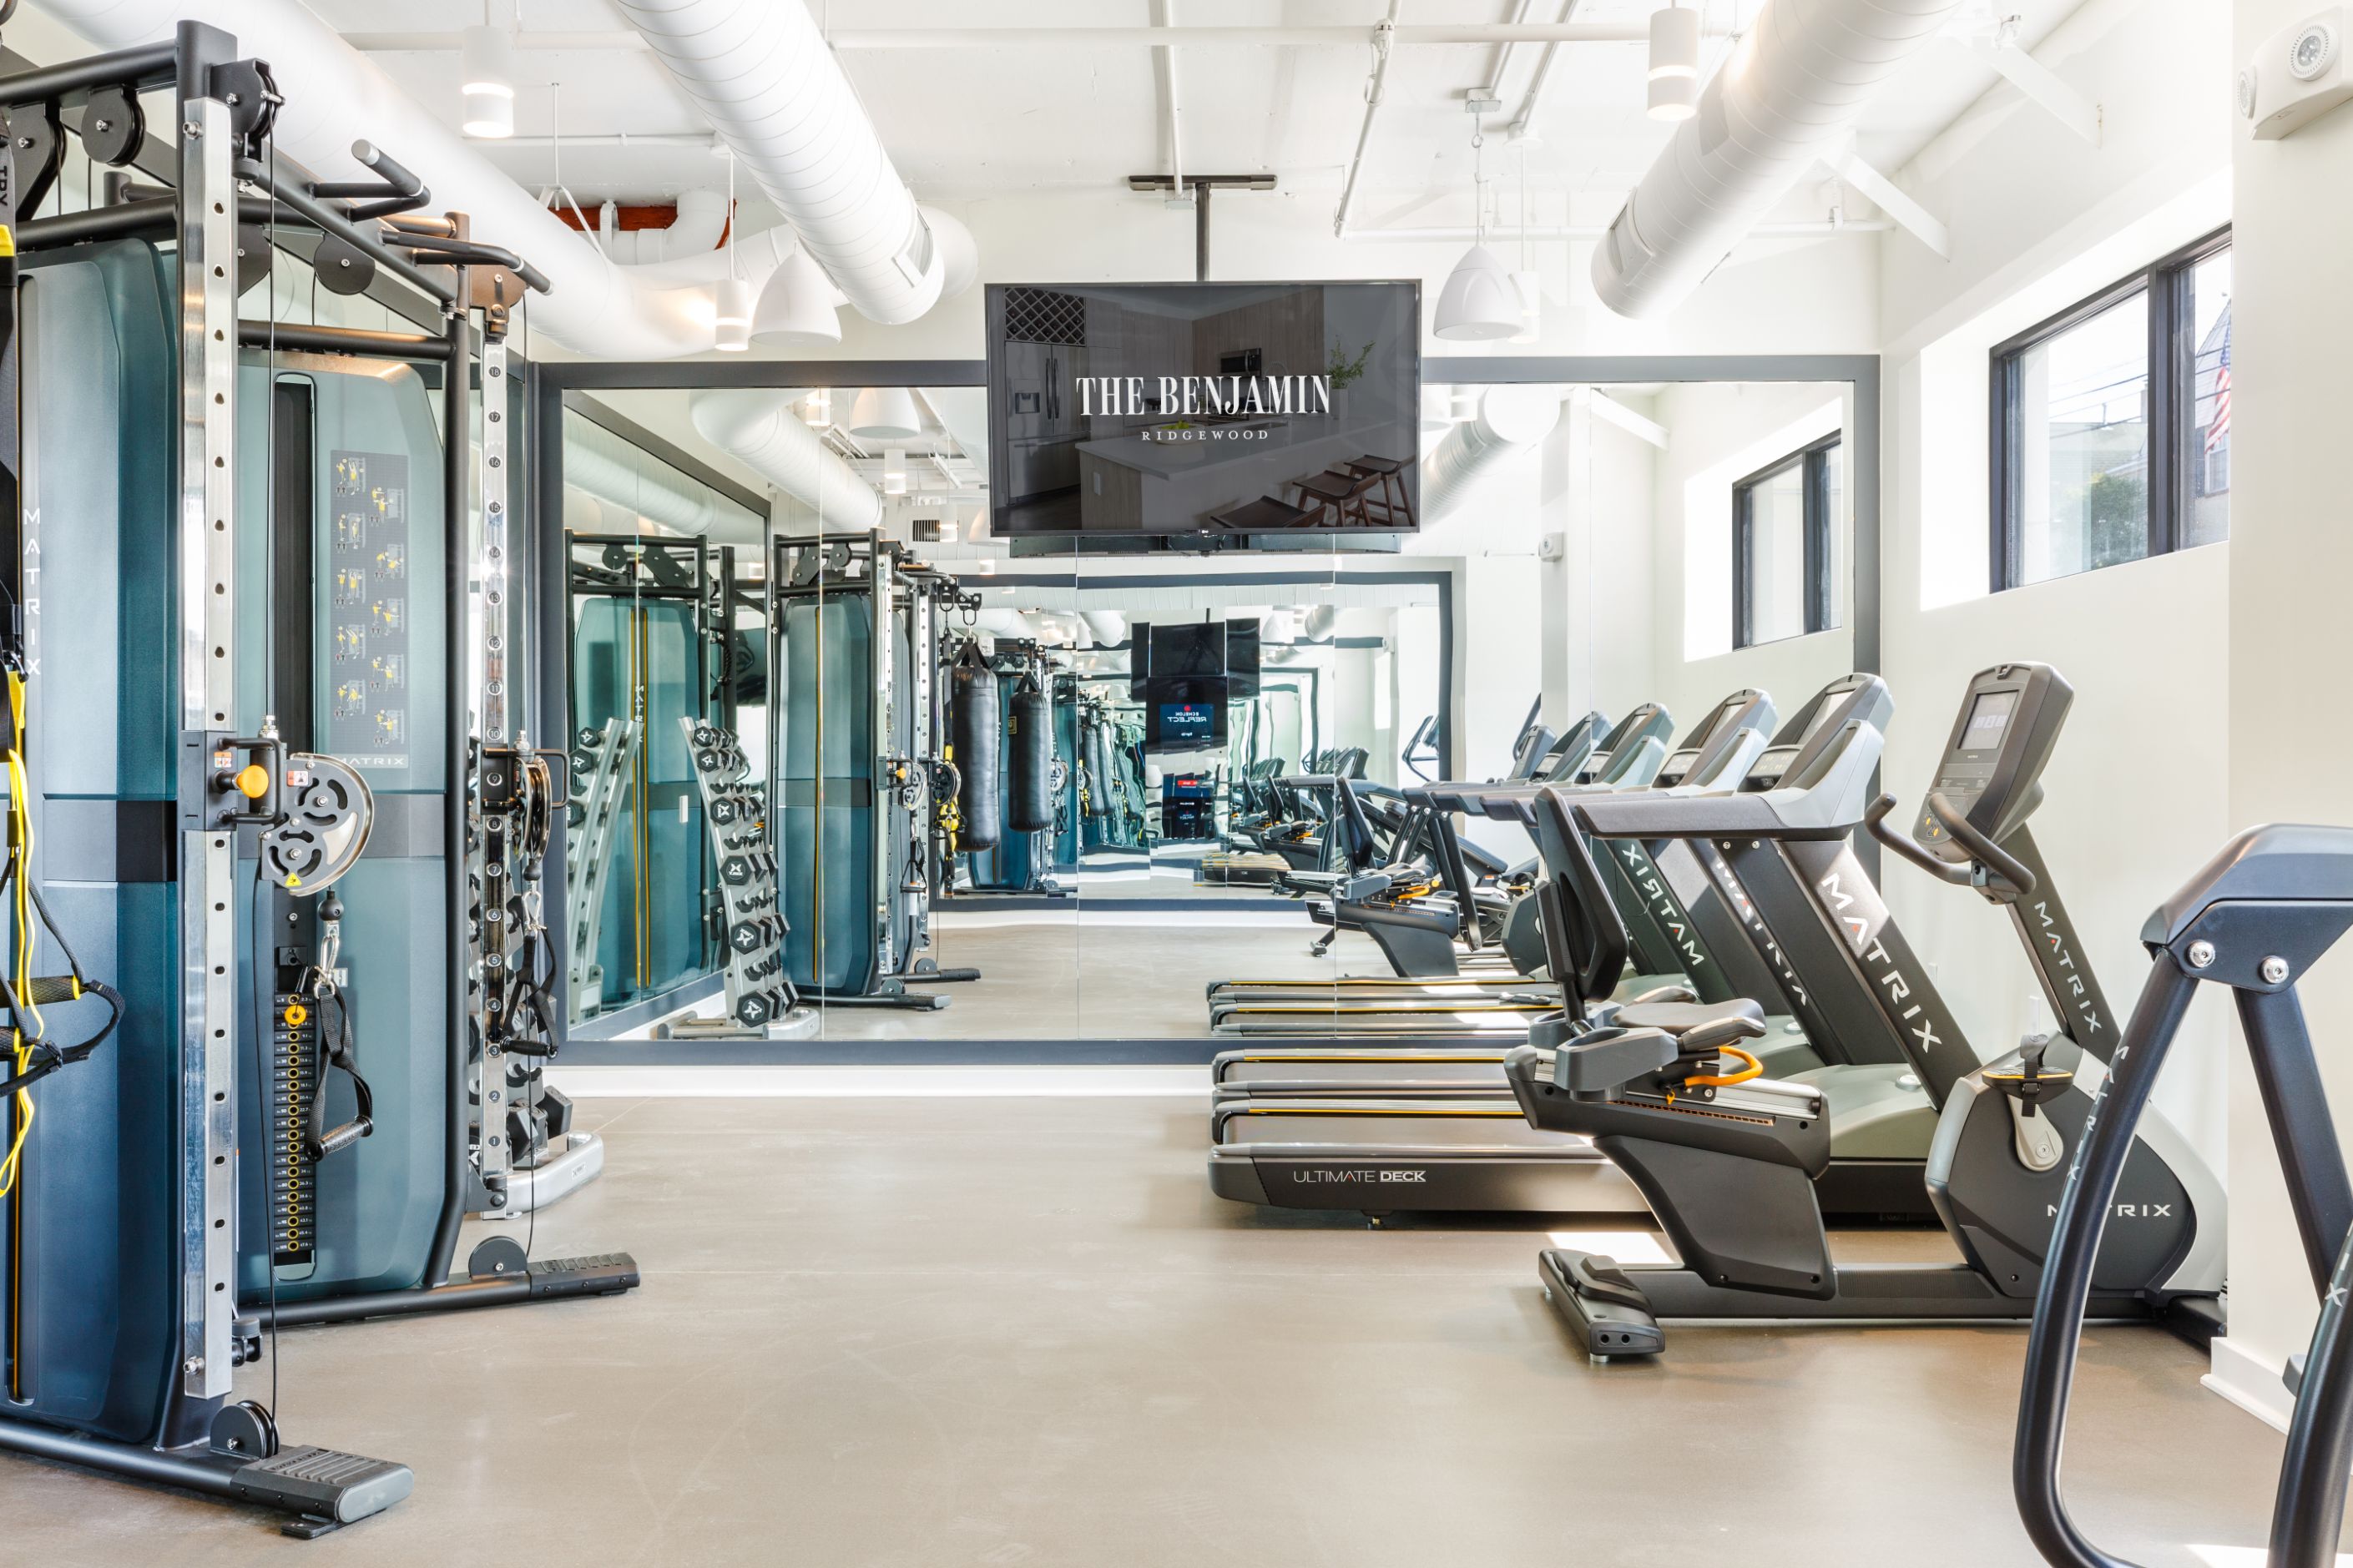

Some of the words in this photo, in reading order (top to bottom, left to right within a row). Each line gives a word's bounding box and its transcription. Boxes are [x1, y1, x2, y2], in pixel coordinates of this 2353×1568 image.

[1076, 376, 1144, 416] THE
[1157, 375, 1332, 416] BENJAMIN
[1141, 429, 1269, 441] RIDGEWOOD
[23, 507, 41, 675] MATRIX
[1820, 872, 1942, 1054] MATRIX
[2034, 900, 2103, 1034] MATRIX
[1293, 1170, 1376, 1182] ULTIMATE
[1380, 1170, 1426, 1182] DECK
[2047, 1204, 2171, 1217] MRIX
